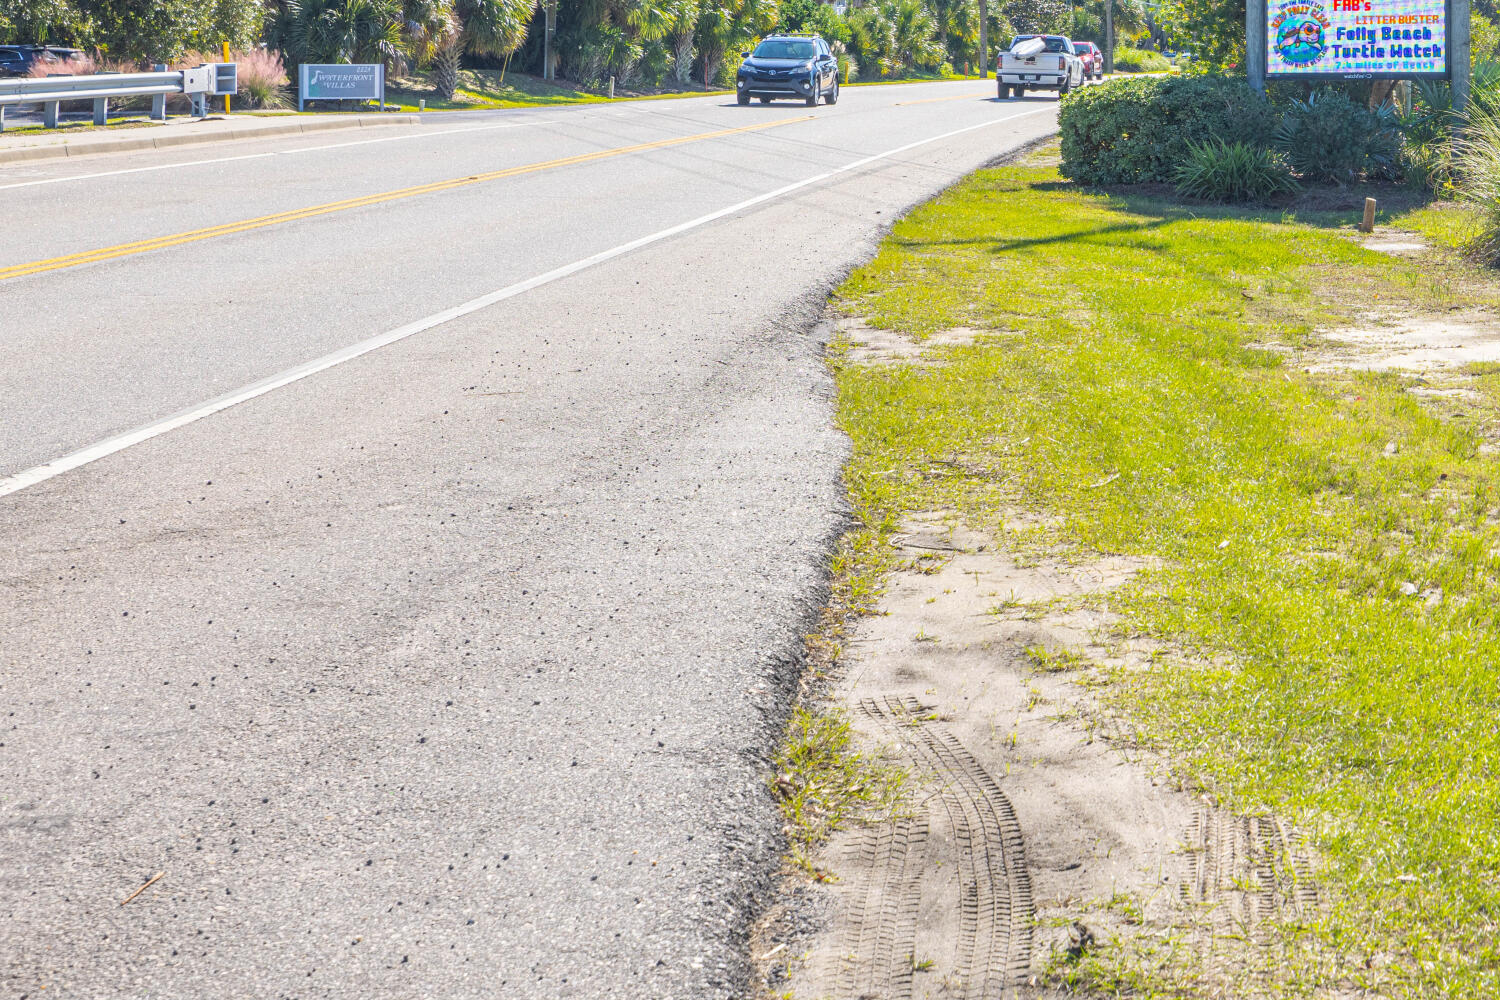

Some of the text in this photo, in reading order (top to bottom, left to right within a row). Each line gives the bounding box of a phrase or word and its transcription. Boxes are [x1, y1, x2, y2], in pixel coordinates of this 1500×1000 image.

[1356, 15, 1440, 24] LITTER BUSTER
[1336, 26, 1432, 44] Folly Beach
[1332, 44, 1442, 58] Turtle Watch
[1355, 61, 1384, 69] miles
[1386, 61, 1399, 69] of
[1402, 61, 1435, 69] Beach
